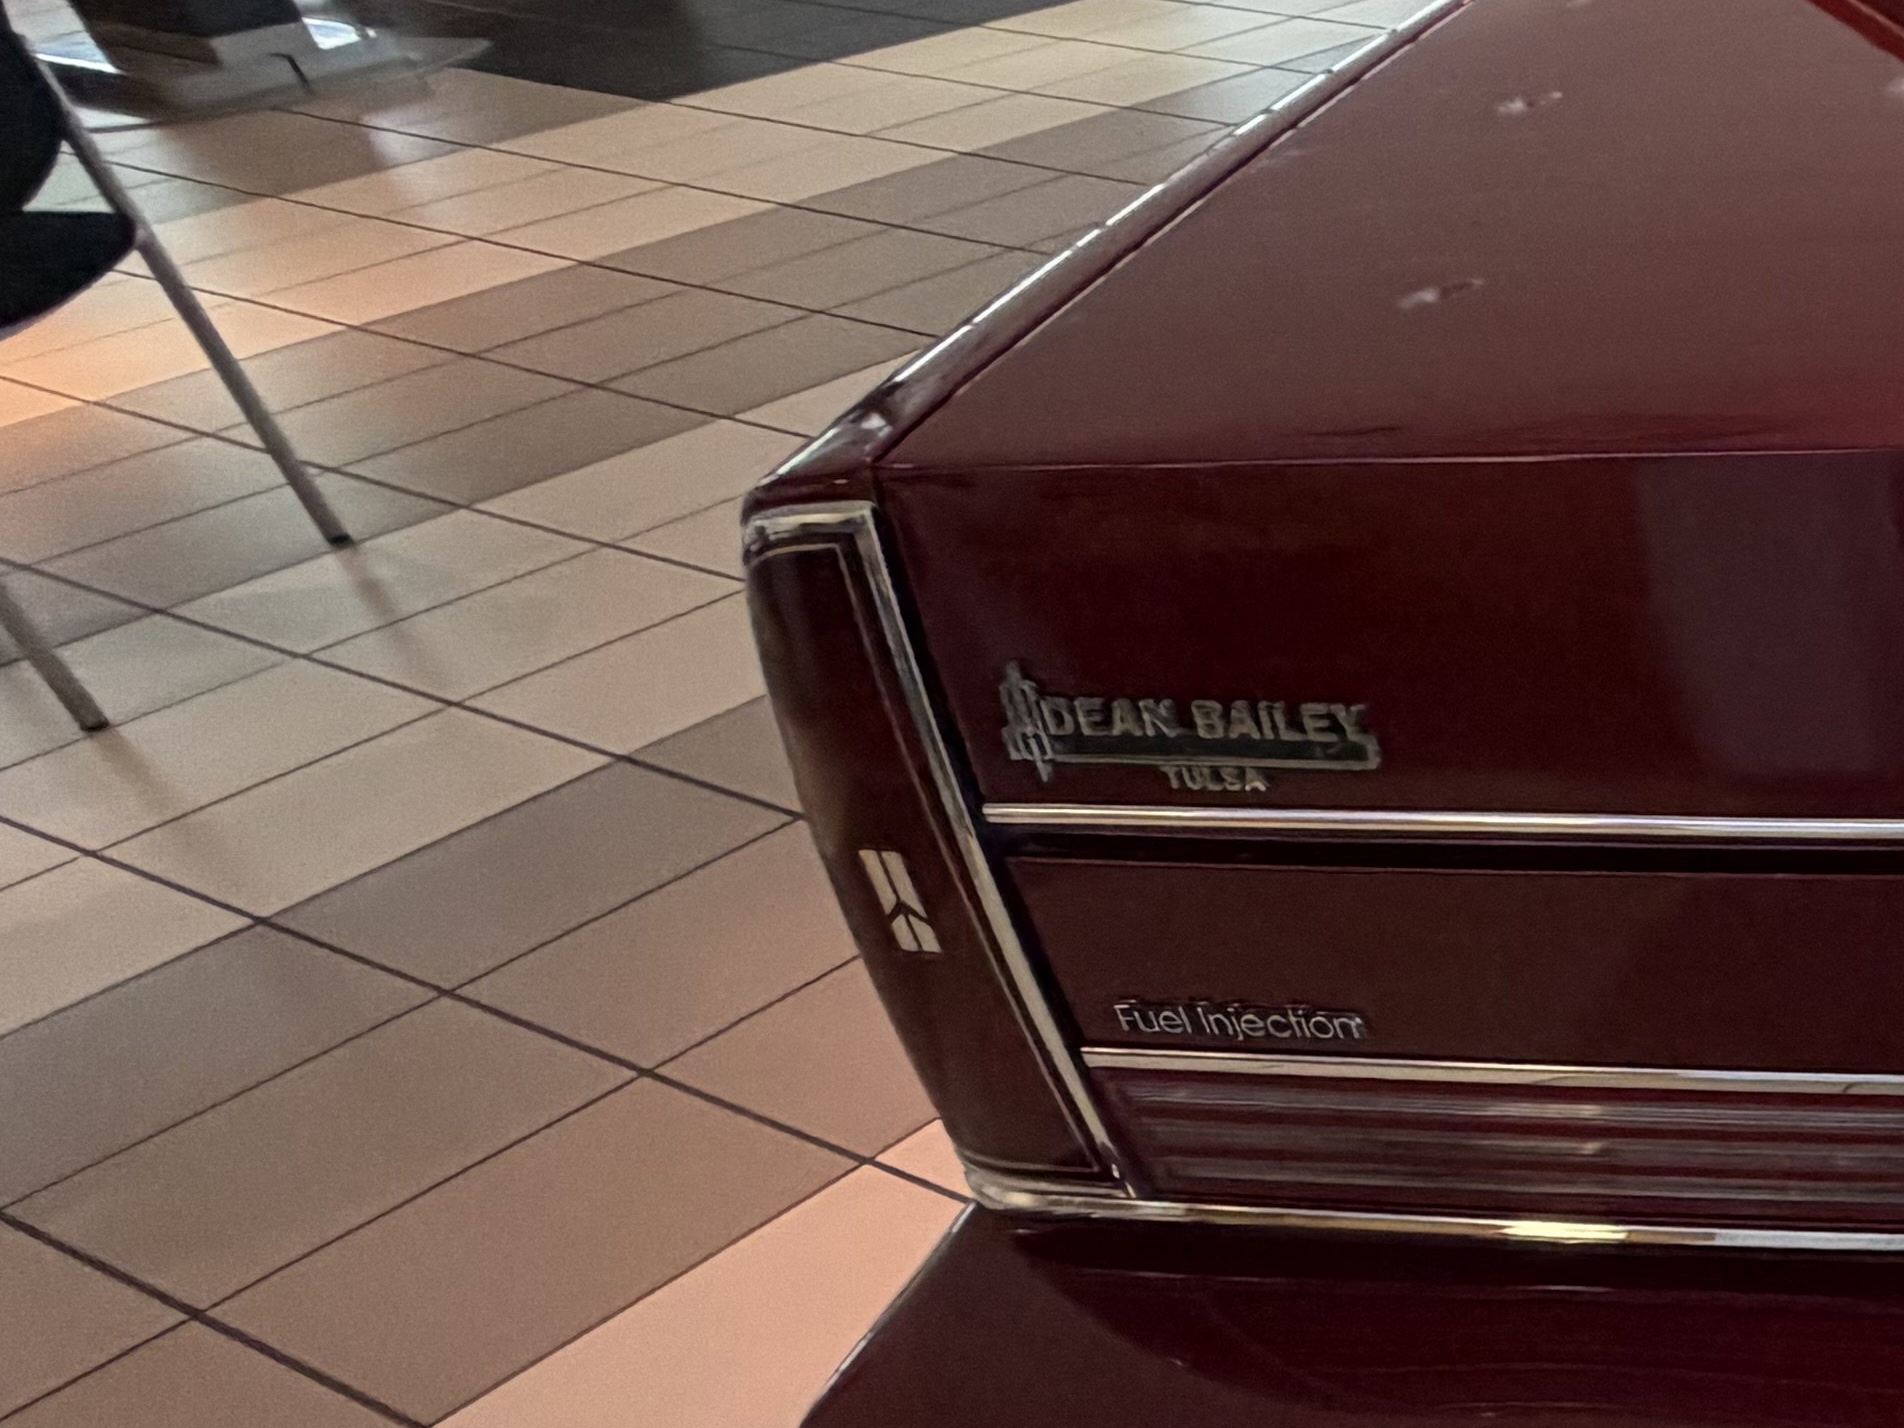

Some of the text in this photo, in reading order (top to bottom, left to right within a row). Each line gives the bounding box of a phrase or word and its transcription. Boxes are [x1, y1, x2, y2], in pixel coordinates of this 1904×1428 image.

[1040, 696, 1367, 742] DEAN BAILEY
[1159, 766, 1269, 791] TULSA
[1113, 1004, 1364, 1041] Fuel Injection
